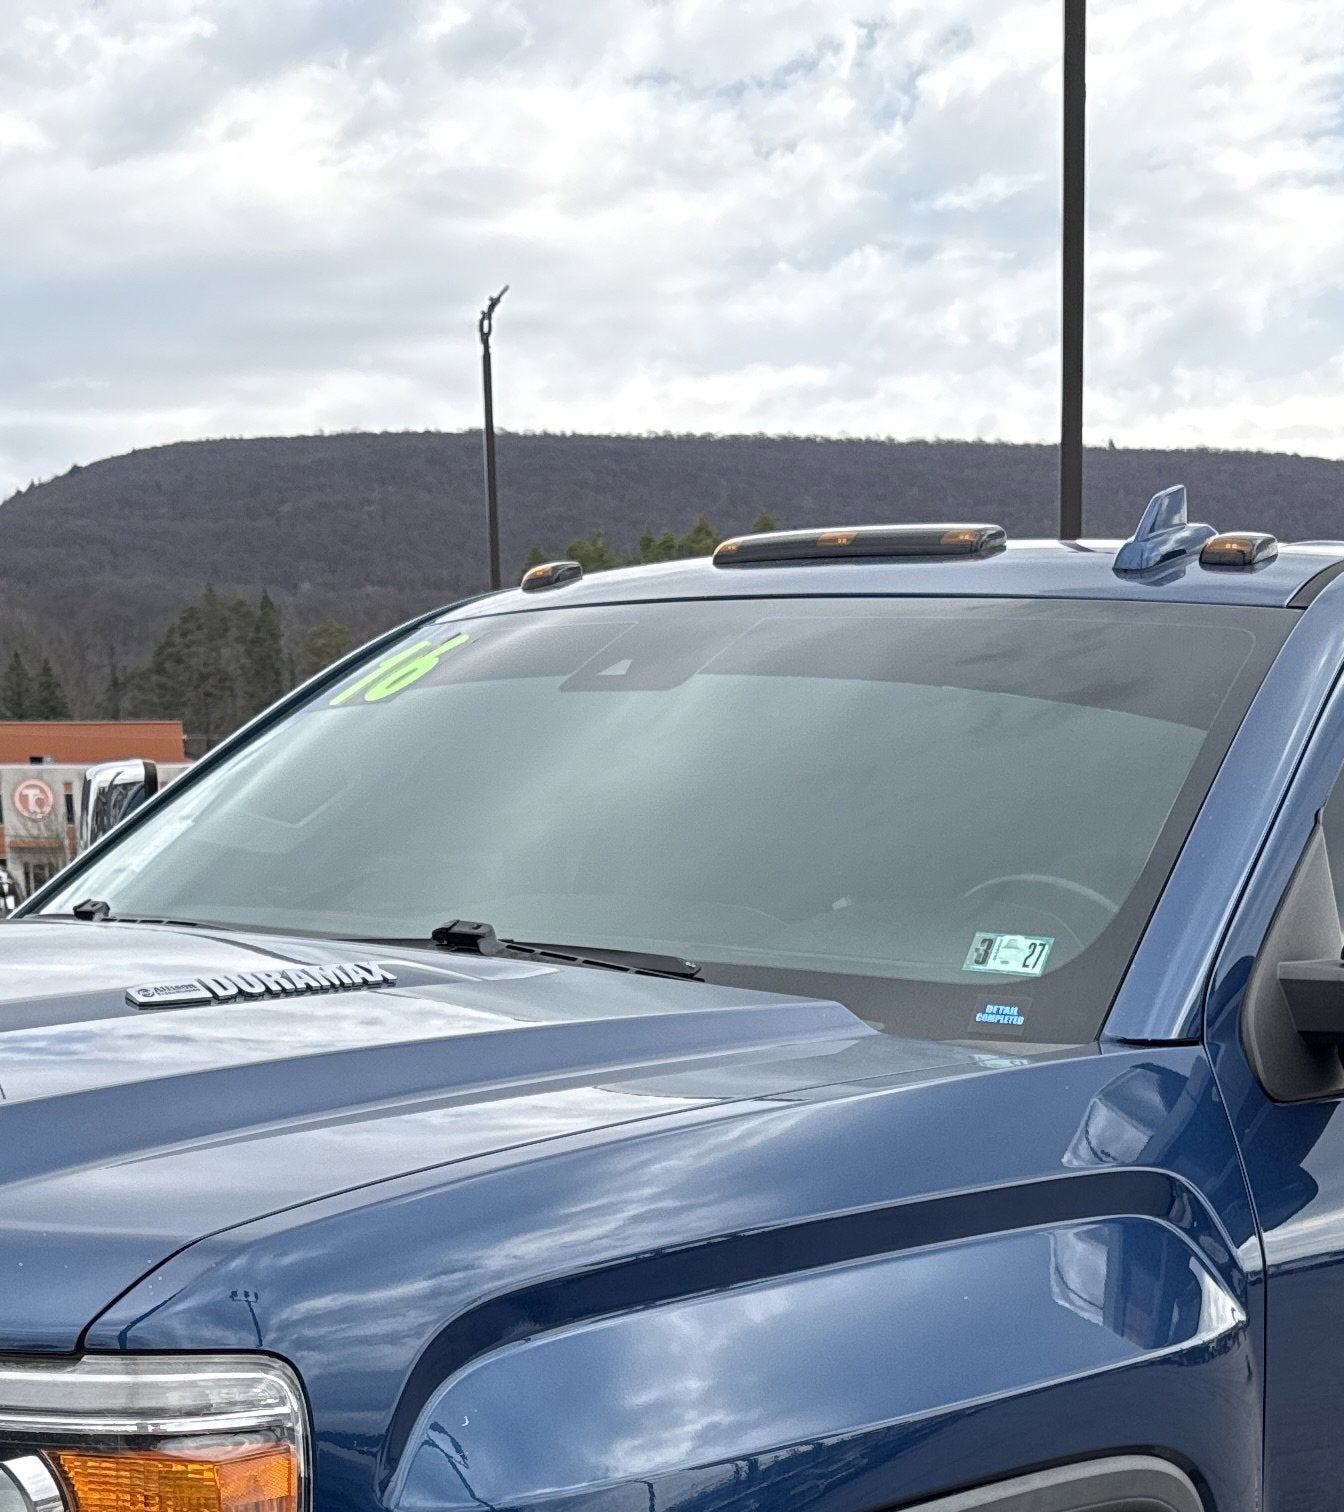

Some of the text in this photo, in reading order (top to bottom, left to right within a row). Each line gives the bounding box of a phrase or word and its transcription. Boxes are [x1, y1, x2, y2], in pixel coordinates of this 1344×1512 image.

[329, 633, 470, 706] 16
[973, 938, 1047, 971] 3 27
[206, 960, 398, 1001] DURAMAX
[975, 1013, 1025, 1026] COMPLETED
[985, 1004, 1019, 1016] DETAIL
